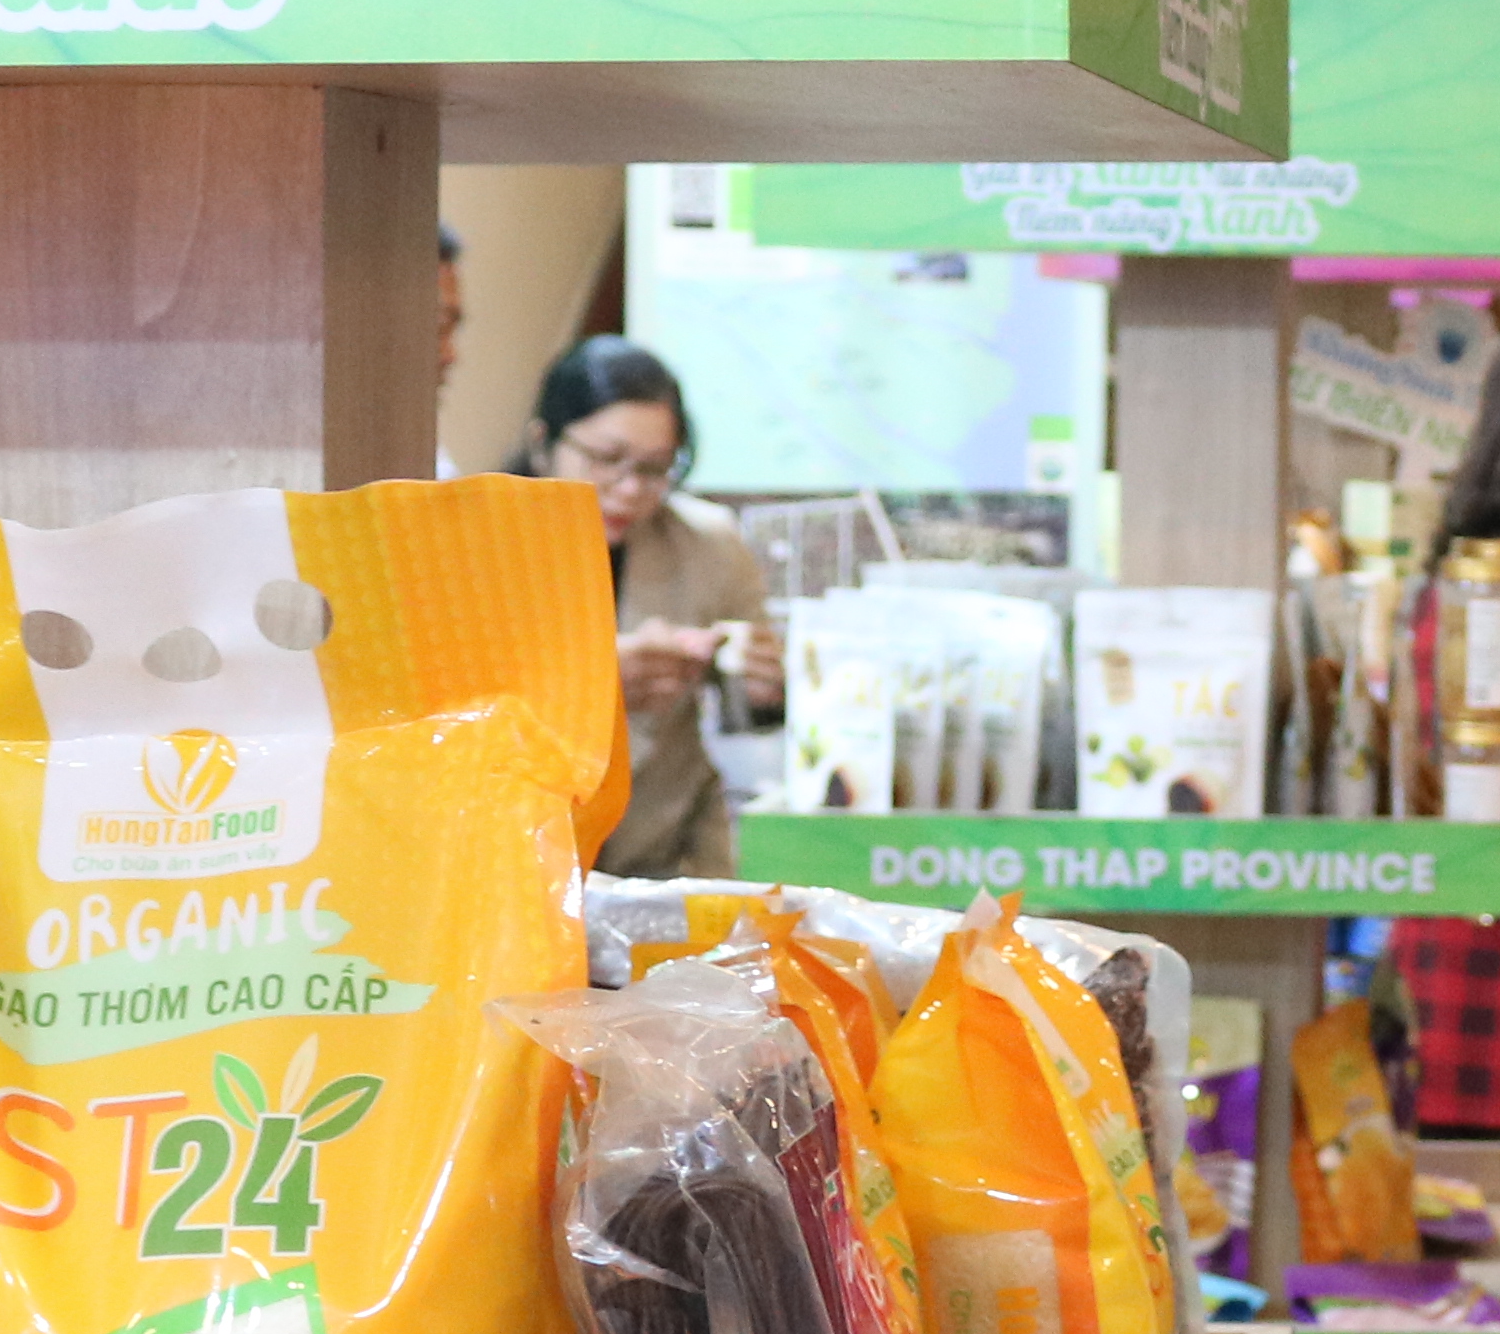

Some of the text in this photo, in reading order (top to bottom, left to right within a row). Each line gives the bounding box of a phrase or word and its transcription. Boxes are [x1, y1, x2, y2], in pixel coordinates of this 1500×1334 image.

[1184, 184, 1312, 233] Xanh
[84, 804, 278, 847] HongTanFood
[72, 855, 114, 873] Cho
[198, 850, 241, 868] sum
[870, 845, 1437, 894] DONG THAP PROVINCE
[25, 876, 334, 971] ORGANIC
[77, 981, 190, 1028] THƠM
[205, 972, 285, 1018] CAO
[302, 962, 390, 1018] CẤP
